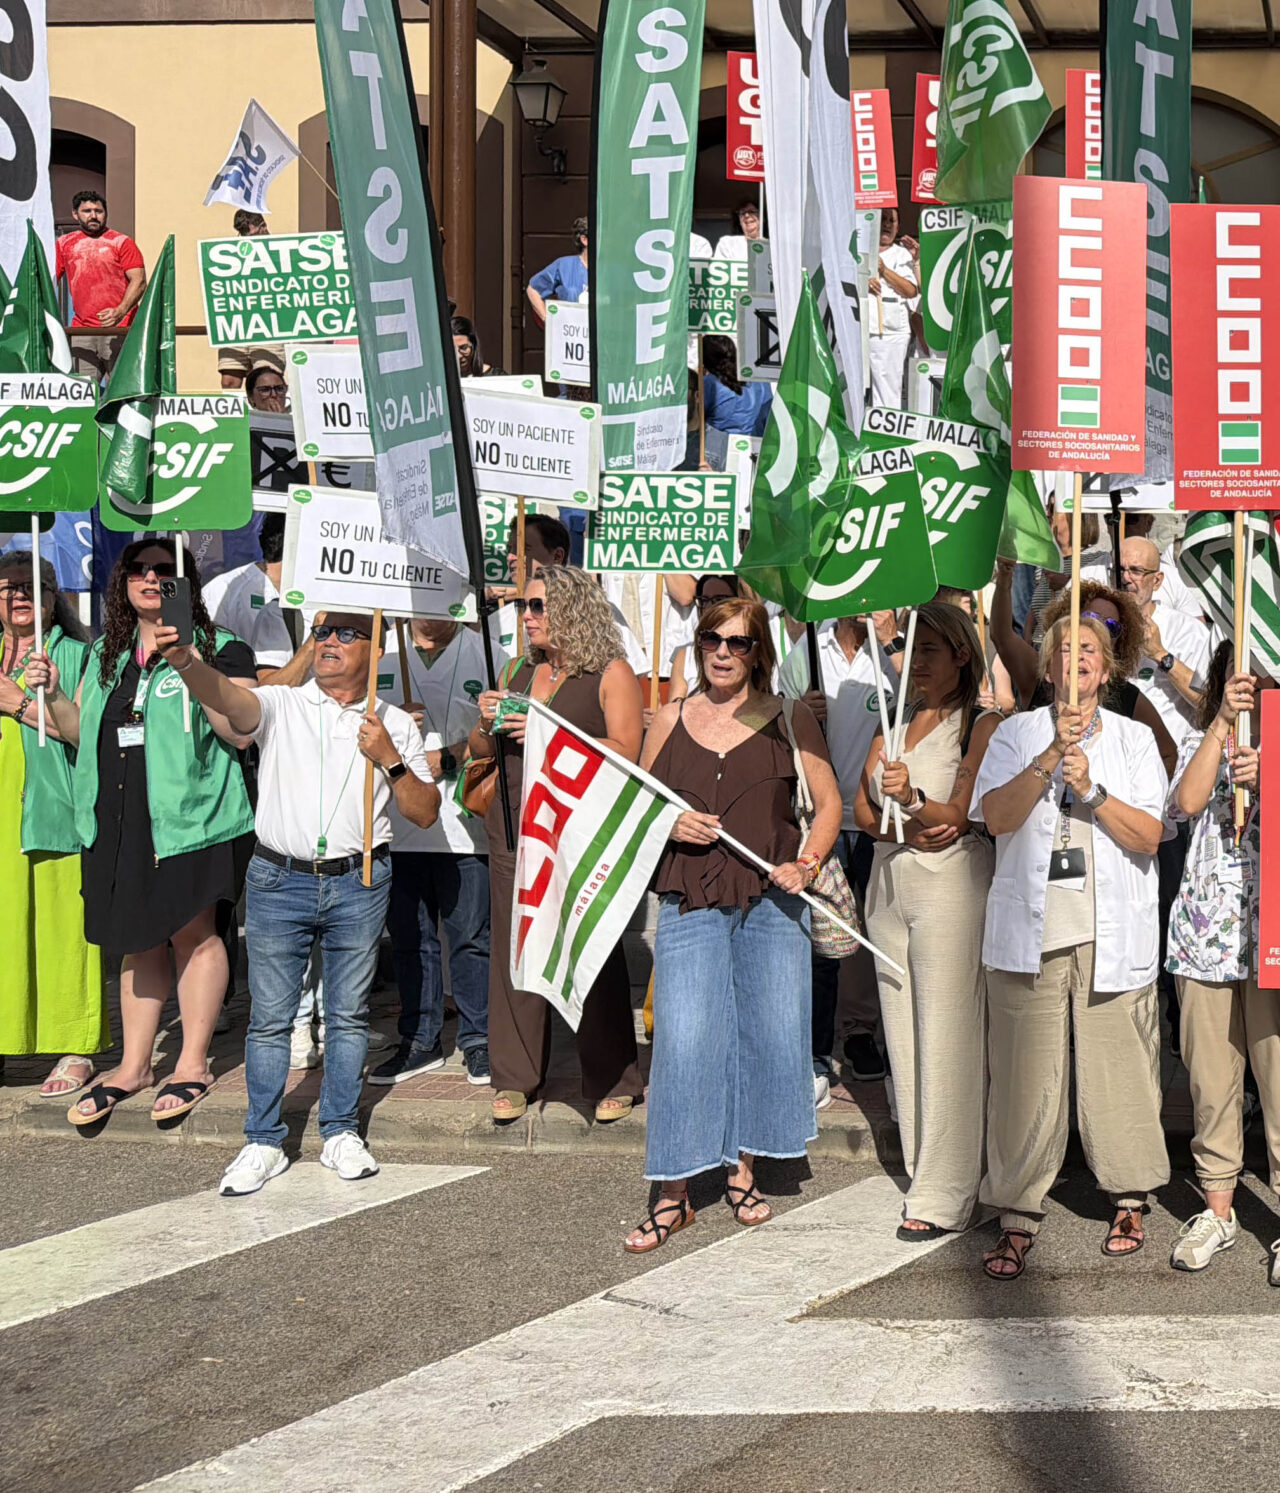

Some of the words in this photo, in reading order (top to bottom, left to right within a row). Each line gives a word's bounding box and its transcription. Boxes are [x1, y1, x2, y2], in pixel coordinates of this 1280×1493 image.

[853, 92, 877, 172] CCOO
[629, 7, 690, 365] SATSE
[924, 208, 963, 231] CSIF
[210, 274, 329, 296] SINDICATO
[335, 274, 350, 288] D
[1058, 185, 1103, 379] CCOO
[213, 290, 354, 313] ENFERMERI
[1215, 211, 1261, 414] CCOO
[563, 324, 580, 338] SOY
[582, 326, 589, 339] U
[565, 342, 584, 361] NO
[21, 377, 96, 401] MÁLAGA
[317, 378, 342, 395] SOY
[344, 378, 362, 395] UN
[608, 373, 676, 405] MÁLAGA
[323, 402, 352, 428] NO
[473, 418, 496, 434] SOY
[498, 420, 514, 437] UN
[517, 423, 575, 445] PACIENTE
[868, 408, 917, 437] CSIF
[926, 420, 982, 451] MALA
[1022, 430, 1076, 440] FEDERACIÓN
[1079, 432, 1090, 440] DE
[1092, 432, 1129, 441] SANIDAD
[1130, 434, 1136, 442] Y
[1018, 439, 1063, 449] SECTORES
[1065, 441, 1140, 452] SOCIOSANITARIOS
[1048, 450, 1060, 459] DE
[1062, 450, 1110, 460] ANDALUCÍA
[475, 440, 500, 466] NO
[504, 452, 518, 468] TU
[522, 455, 571, 475] CLIENTE
[608, 454, 634, 468] SATSE
[1179, 480, 1224, 488] SECTORES
[1183, 469, 1238, 478] FEDERACIÓN
[1240, 470, 1251, 478] DE
[600, 476, 732, 509] SATSE
[1210, 489, 1222, 498] DE
[1224, 488, 1272, 498] ANDALUCÍA
[594, 511, 698, 526] SINDICATO
[702, 511, 729, 526] DE
[320, 521, 350, 539] SOY
[354, 524, 374, 543] UN
[593, 526, 729, 541] ENFERMERIA
[320, 546, 355, 575] NO
[360, 560, 378, 578] TU
[382, 563, 443, 585] CLIENTE
[592, 543, 727, 569] MALAGA
[574, 863, 611, 916] málaga
